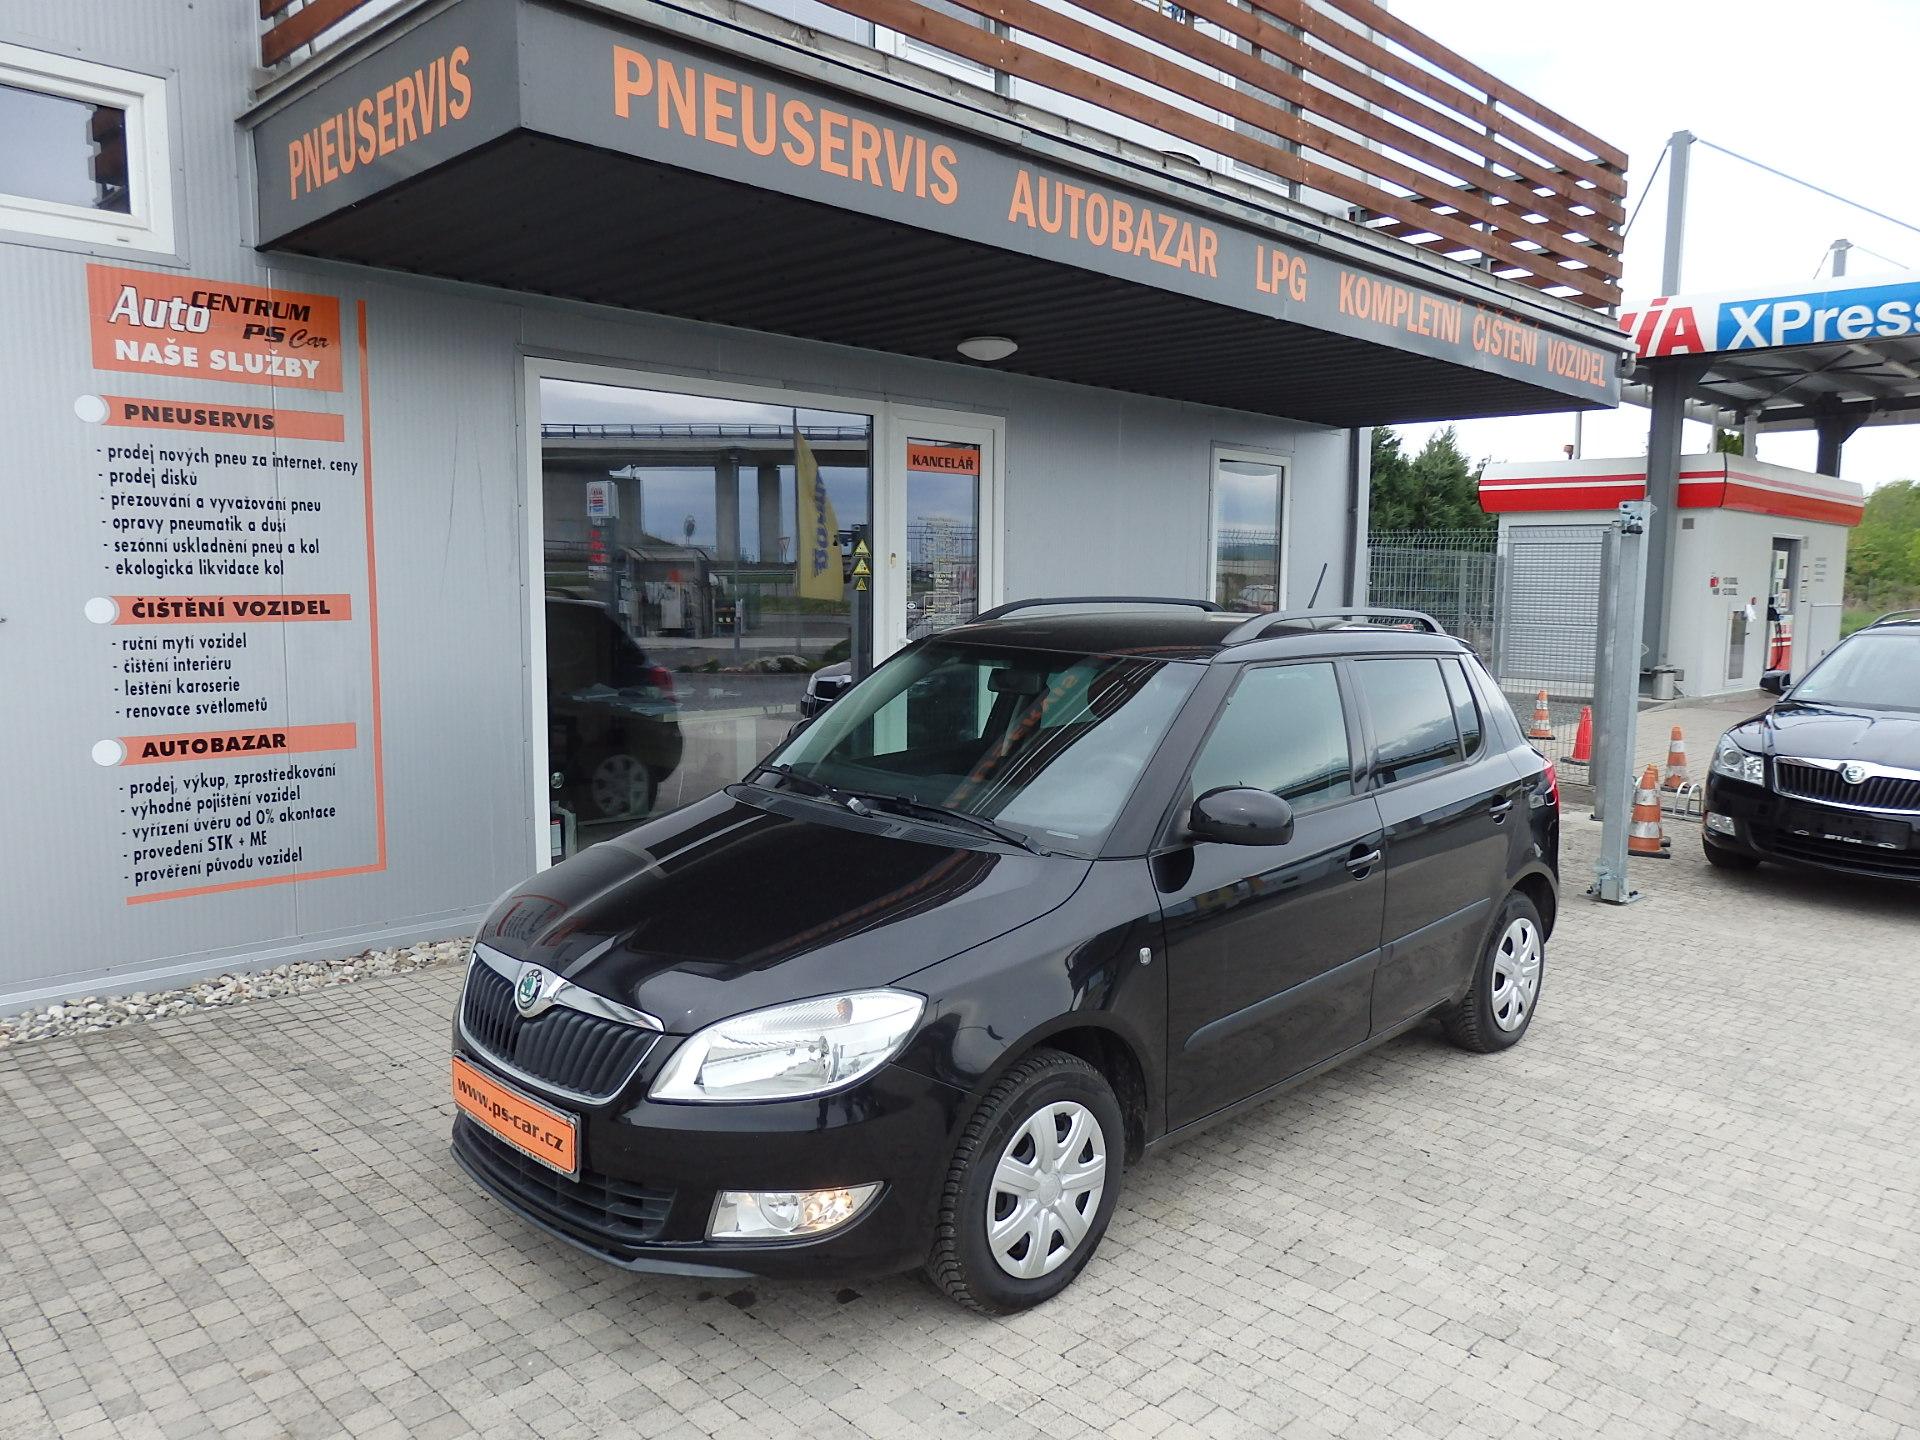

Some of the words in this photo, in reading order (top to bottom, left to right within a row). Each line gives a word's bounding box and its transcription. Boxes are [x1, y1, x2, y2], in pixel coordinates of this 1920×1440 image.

[289, 45, 472, 200] PNEUSERVIS
[612, 44, 959, 205] PNEUSERVIS
[1008, 169, 1218, 278] AUTOBAZAR
[1256, 245, 1308, 303] LPG
[1340, 271, 1464, 344] KOMPLETNÍ
[1472, 303, 1540, 366] ČIŠTĚNÍ
[1547, 336, 1605, 388] VOZIDEL
[108, 284, 211, 334] Auto
[191, 290, 311, 322] CENTRUM
[242, 323, 287, 343] PS
[288, 329, 331, 349] Car
[1727, 300, 1920, 351] XPres
[114, 337, 198, 369] NAŠE
[209, 349, 320, 379] SLUŽBY
[124, 403, 275, 431] PNEUSERVIS
[108, 444, 154, 464] prodej
[160, 447, 208, 466] nových
[215, 451, 246, 467] pneu
[252, 454, 267, 466] za
[272, 452, 325, 471] internet.
[330, 460, 358, 475] ceny
[912, 454, 974, 470] KANCELÁŘ
[110, 468, 155, 488] prodej
[111, 492, 190, 510] přezouvání
[197, 496, 204, 508] a
[210, 496, 286, 513] vyvažování
[291, 500, 321, 514] pneu
[112, 517, 163, 533] opravy
[170, 515, 242, 533] pneumatik
[248, 520, 256, 532] a
[114, 537, 167, 553] sezónní
[173, 537, 247, 553] uskladnění
[252, 542, 283, 557] pneu
[288, 542, 295, 553] a
[300, 538, 320, 554] kol
[116, 558, 194, 579] ekologická
[199, 559, 259, 575] likvidace
[264, 559, 284, 575] kol
[132, 597, 225, 618] ČIŠTĚNÍ
[233, 600, 331, 616] VOZIDEL
[122, 635, 157, 651] ruční
[162, 635, 195, 653] mytí
[199, 633, 247, 649] vozidel
[124, 657, 169, 673] čištění
[173, 655, 232, 672] interiéru
[125, 679, 172, 696] leštění
[176, 677, 240, 693] karoserie
[126, 703, 190, 719] renovace
[196, 697, 268, 715] světlometů
[142, 733, 286, 758] AUTOBAZAR
[130, 776, 178, 798] prodej,
[183, 772, 229, 793] výkup,
[234, 763, 336, 787] zprostředkování
[131, 799, 191, 820] výhodné
[197, 792, 251, 813] pojištění
[256, 785, 301, 804] vozidel
[132, 821, 189, 842] vyřízení
[194, 816, 231, 833] úvěru
[236, 810, 251, 828] od
[256, 808, 275, 825] 0%
[279, 805, 336, 822] akontace
[134, 842, 203, 864] provedení
[208, 834, 233, 852] STK
[239, 837, 245, 847] +
[250, 830, 267, 847] ME
[135, 863, 201, 886] prověření
[206, 854, 253, 876] původu
[258, 847, 302, 866] vozidel
[457, 1077, 564, 1153] www.ps-car.cz
